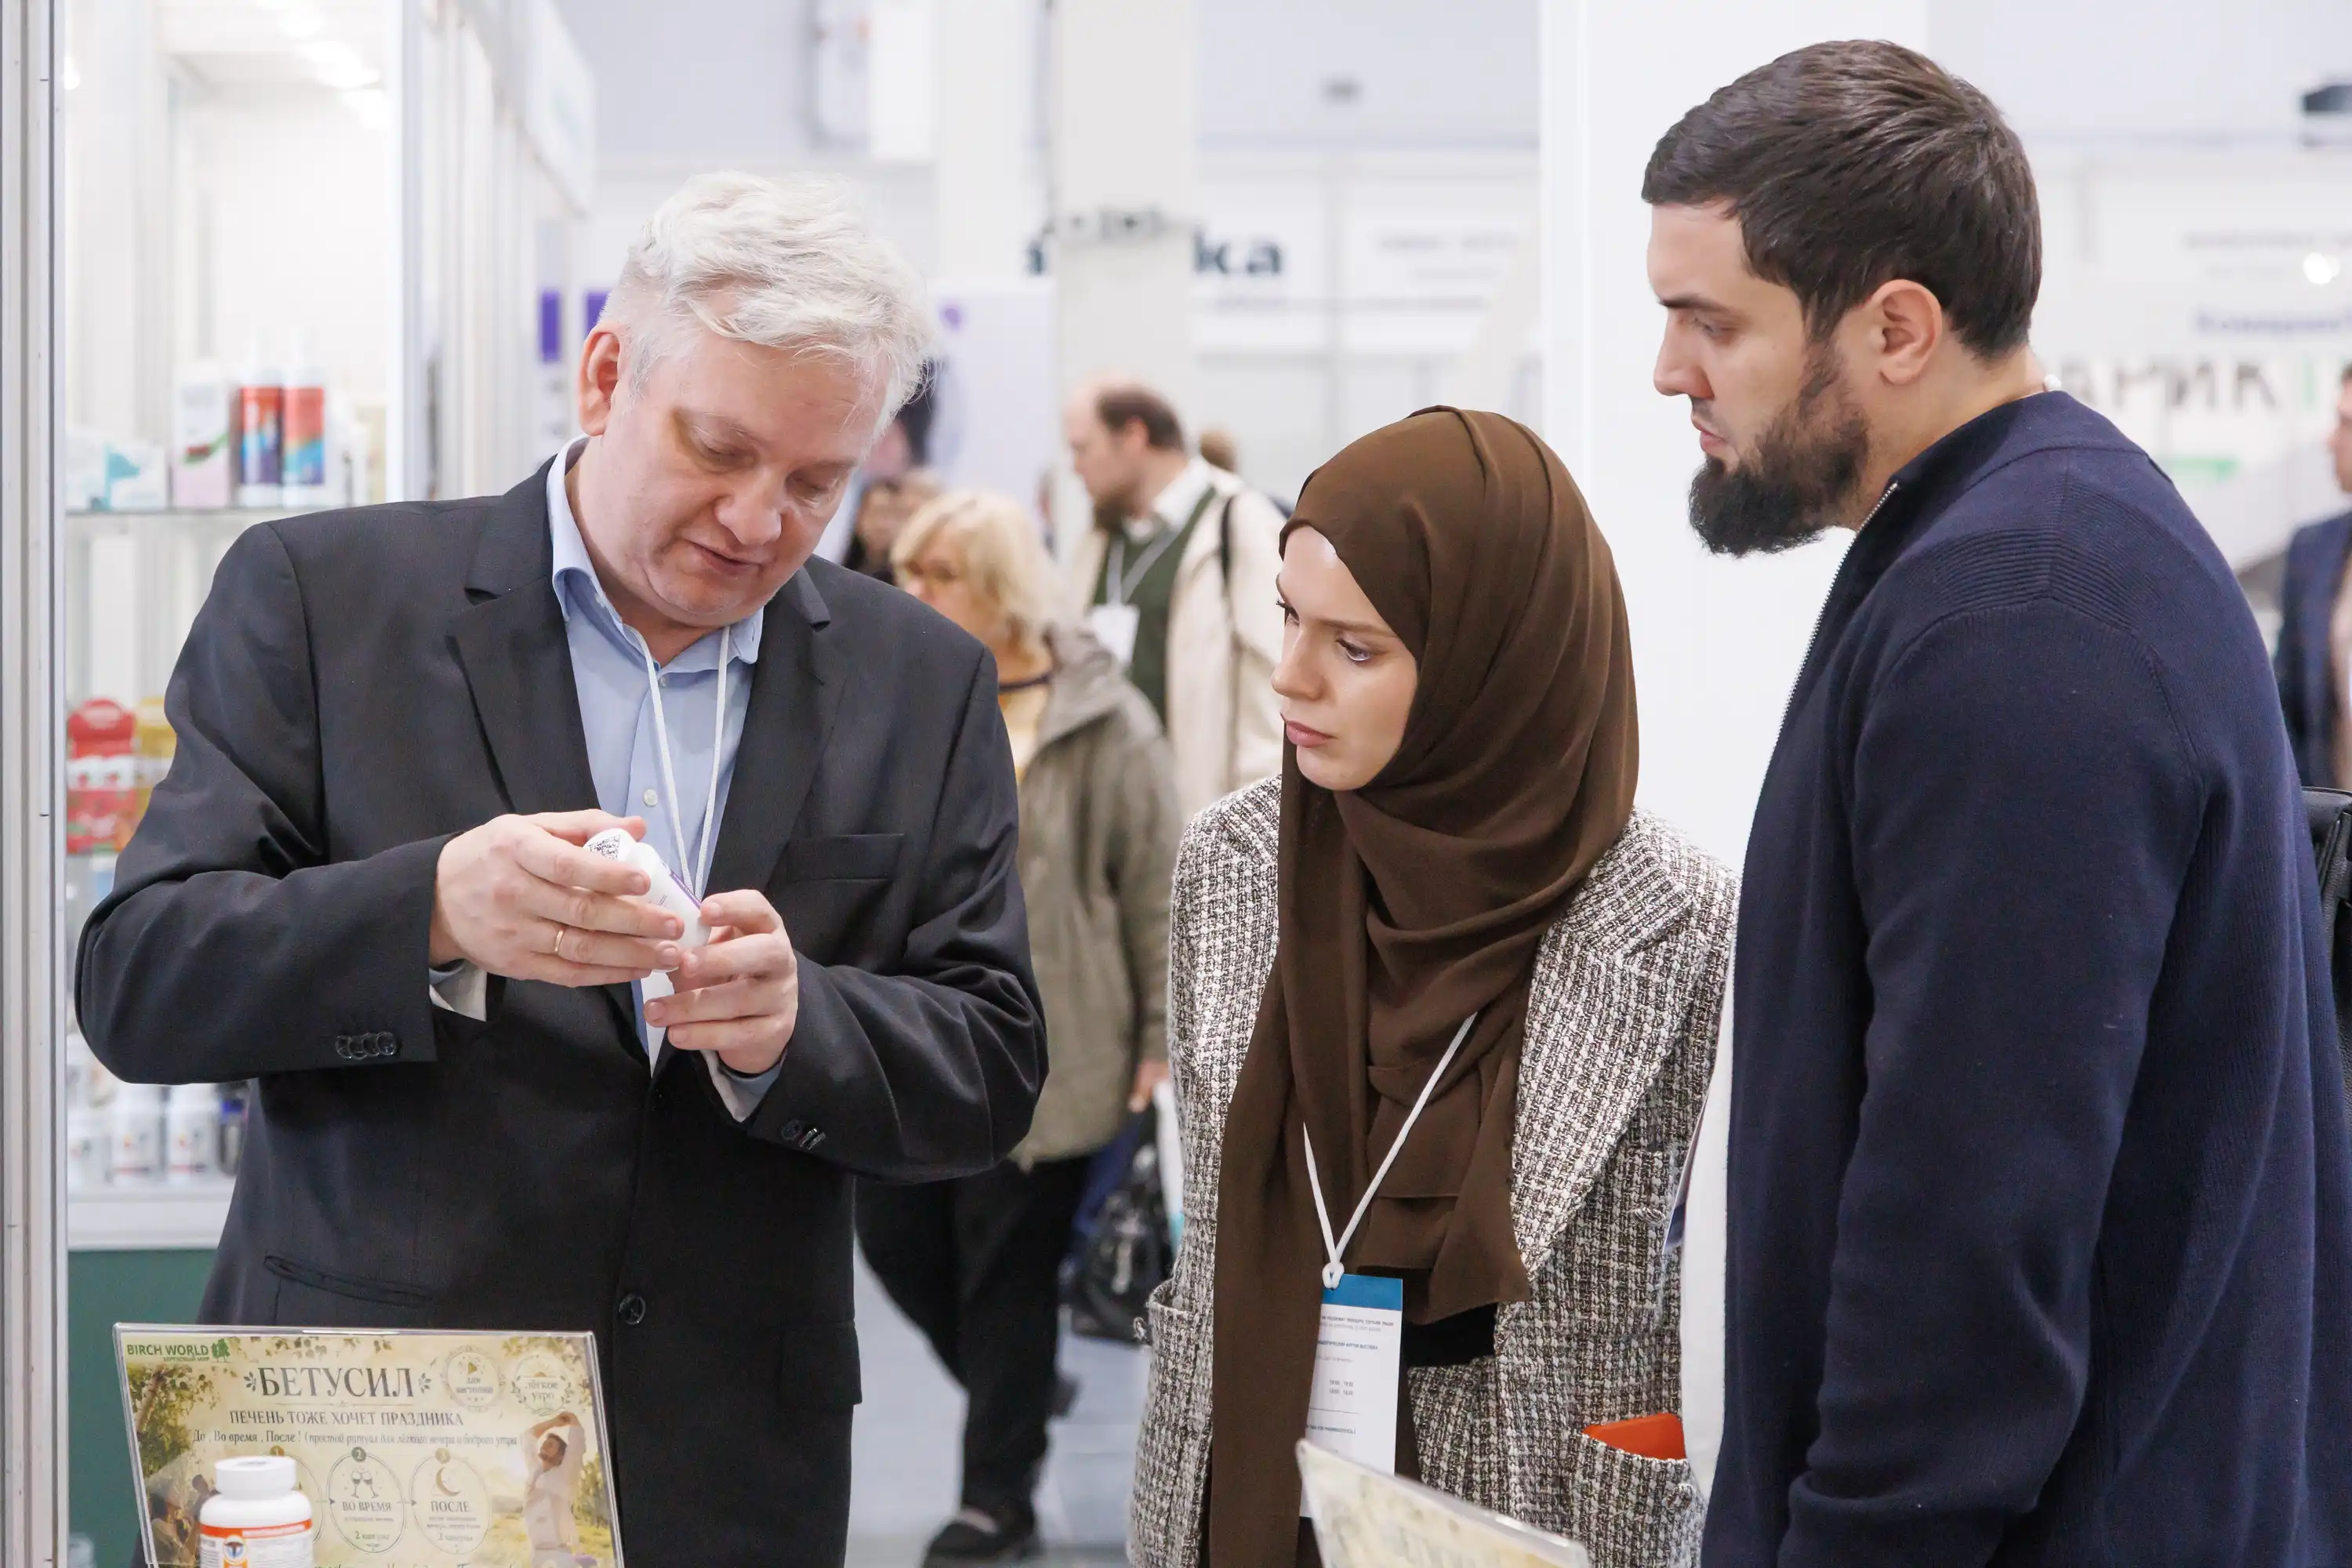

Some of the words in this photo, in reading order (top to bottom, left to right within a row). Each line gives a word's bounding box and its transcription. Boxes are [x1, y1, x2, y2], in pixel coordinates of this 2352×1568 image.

[126, 1344, 162, 1356] BIRCH
[165, 1345, 209, 1356] WORLD
[257, 1367, 414, 1398] БЕТУСИЛ
[230, 1410, 285, 1424] ПЕЧЕНЬ
[286, 1411, 328, 1425] ТОЖЕ
[332, 1412, 376, 1425] ХОЧЕТ
[381, 1412, 464, 1426] ПРАЗДНИКА
[214, 1430, 227, 1442] Во
[343, 1501, 356, 1512] ВО
[358, 1501, 392, 1513] ВРЕМЯ
[430, 1501, 472, 1513] ПОСЛЕ
